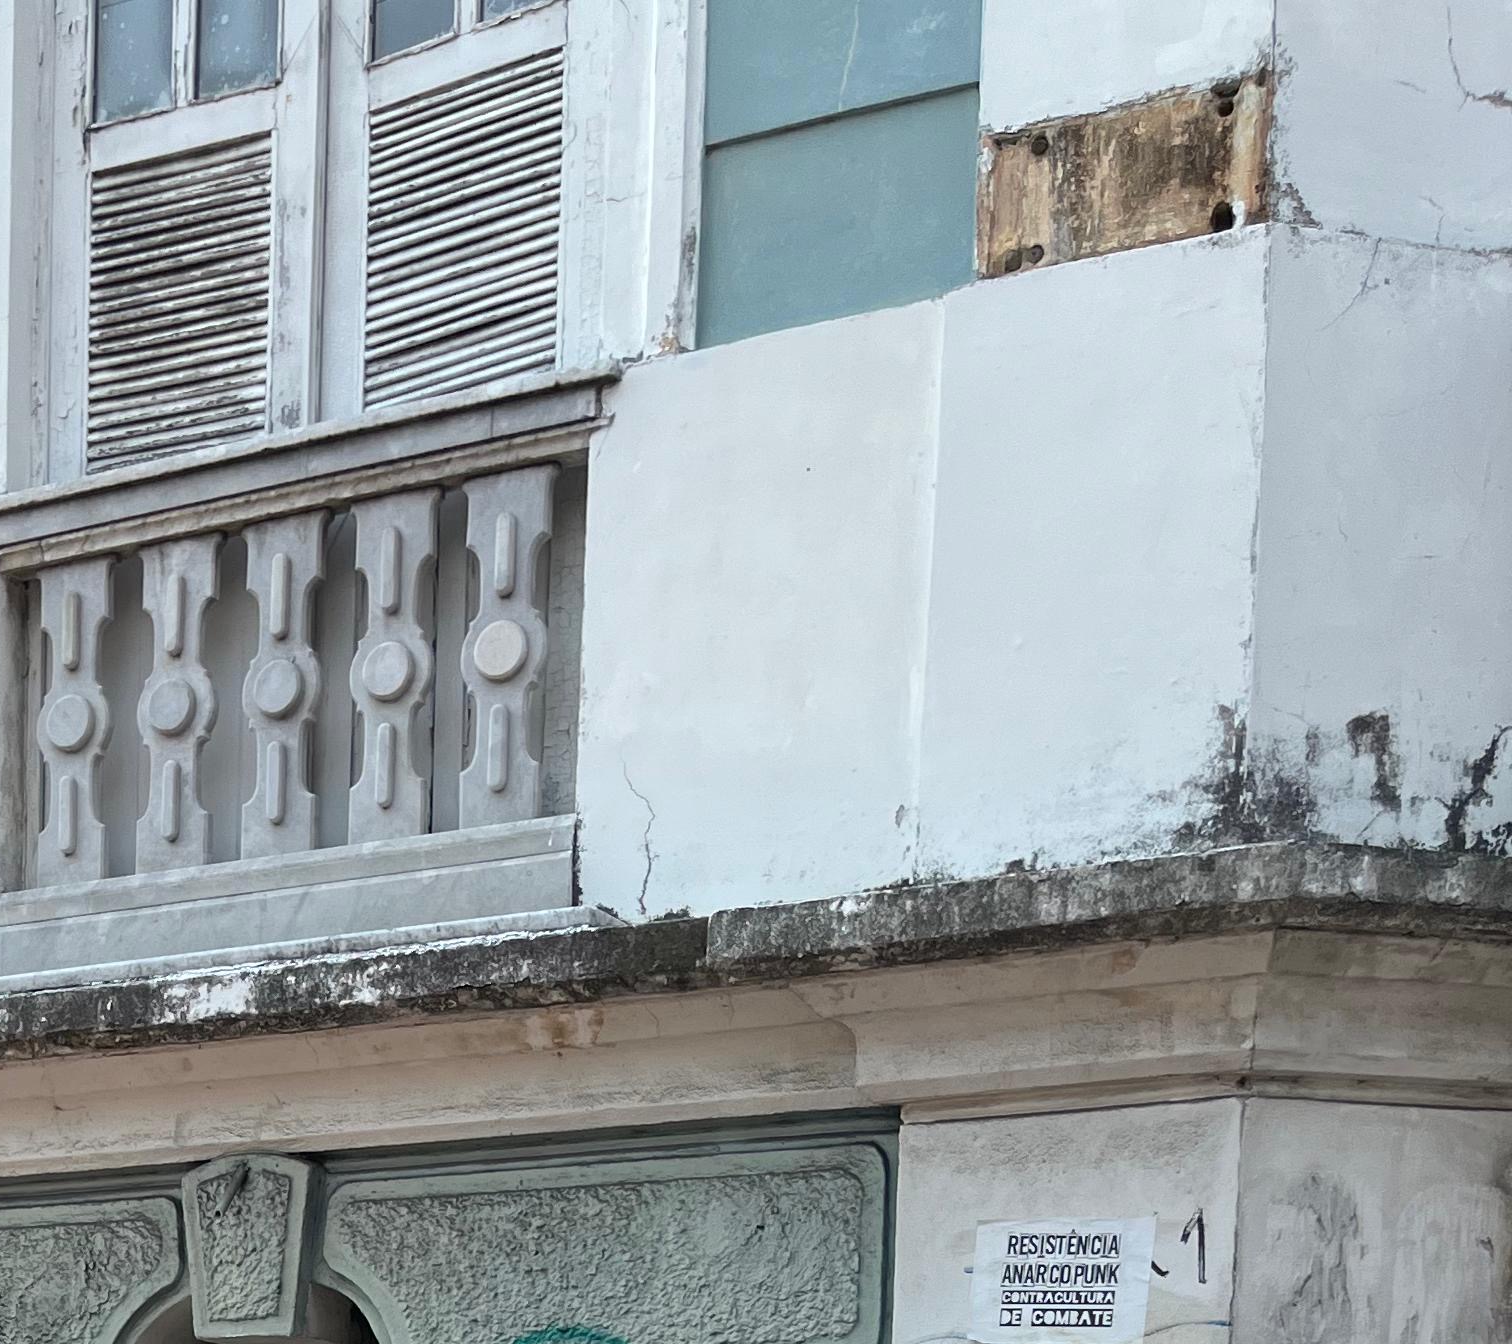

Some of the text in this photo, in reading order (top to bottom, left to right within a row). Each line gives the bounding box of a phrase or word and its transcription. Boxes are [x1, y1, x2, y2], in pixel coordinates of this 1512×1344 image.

[1006, 1228, 1120, 1258] RESISTÊNCIA
[1001, 1290, 1115, 1305] CONTRACULTURA
[999, 1308, 1114, 1327] DE COMBATE
